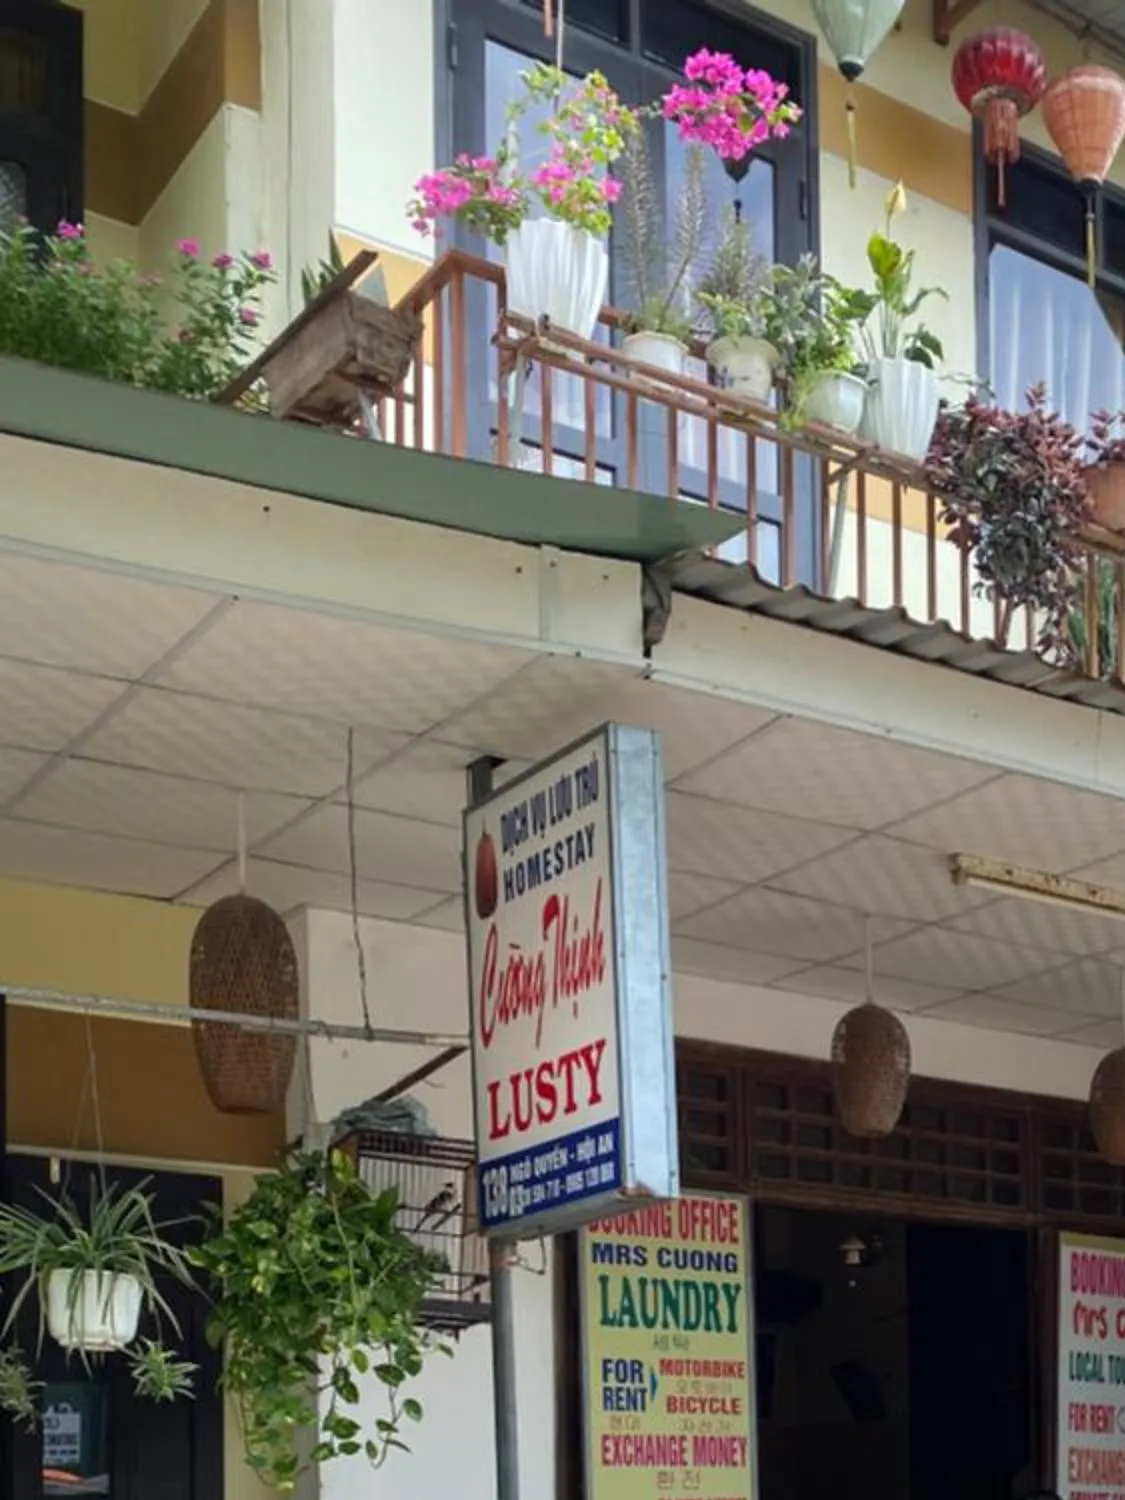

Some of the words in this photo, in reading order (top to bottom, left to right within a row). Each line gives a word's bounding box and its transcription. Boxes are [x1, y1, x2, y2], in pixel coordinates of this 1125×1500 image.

[503, 822, 595, 904] HOMESTAY
[487, 1039, 607, 1140] LUSTY
[678, 1197, 740, 1245] OFFICE
[591, 1241, 648, 1267] MRS
[656, 1247, 739, 1274] CUONG
[598, 1274, 742, 1334] LAUNDRY
[602, 1357, 645, 1384] FOR
[658, 1357, 746, 1379] MOTORBIKE
[603, 1386, 648, 1412] RENT
[666, 1395, 744, 1416] BICYCLE
[601, 1433, 688, 1467] EXCHANGE
[693, 1435, 748, 1468] MONEY
